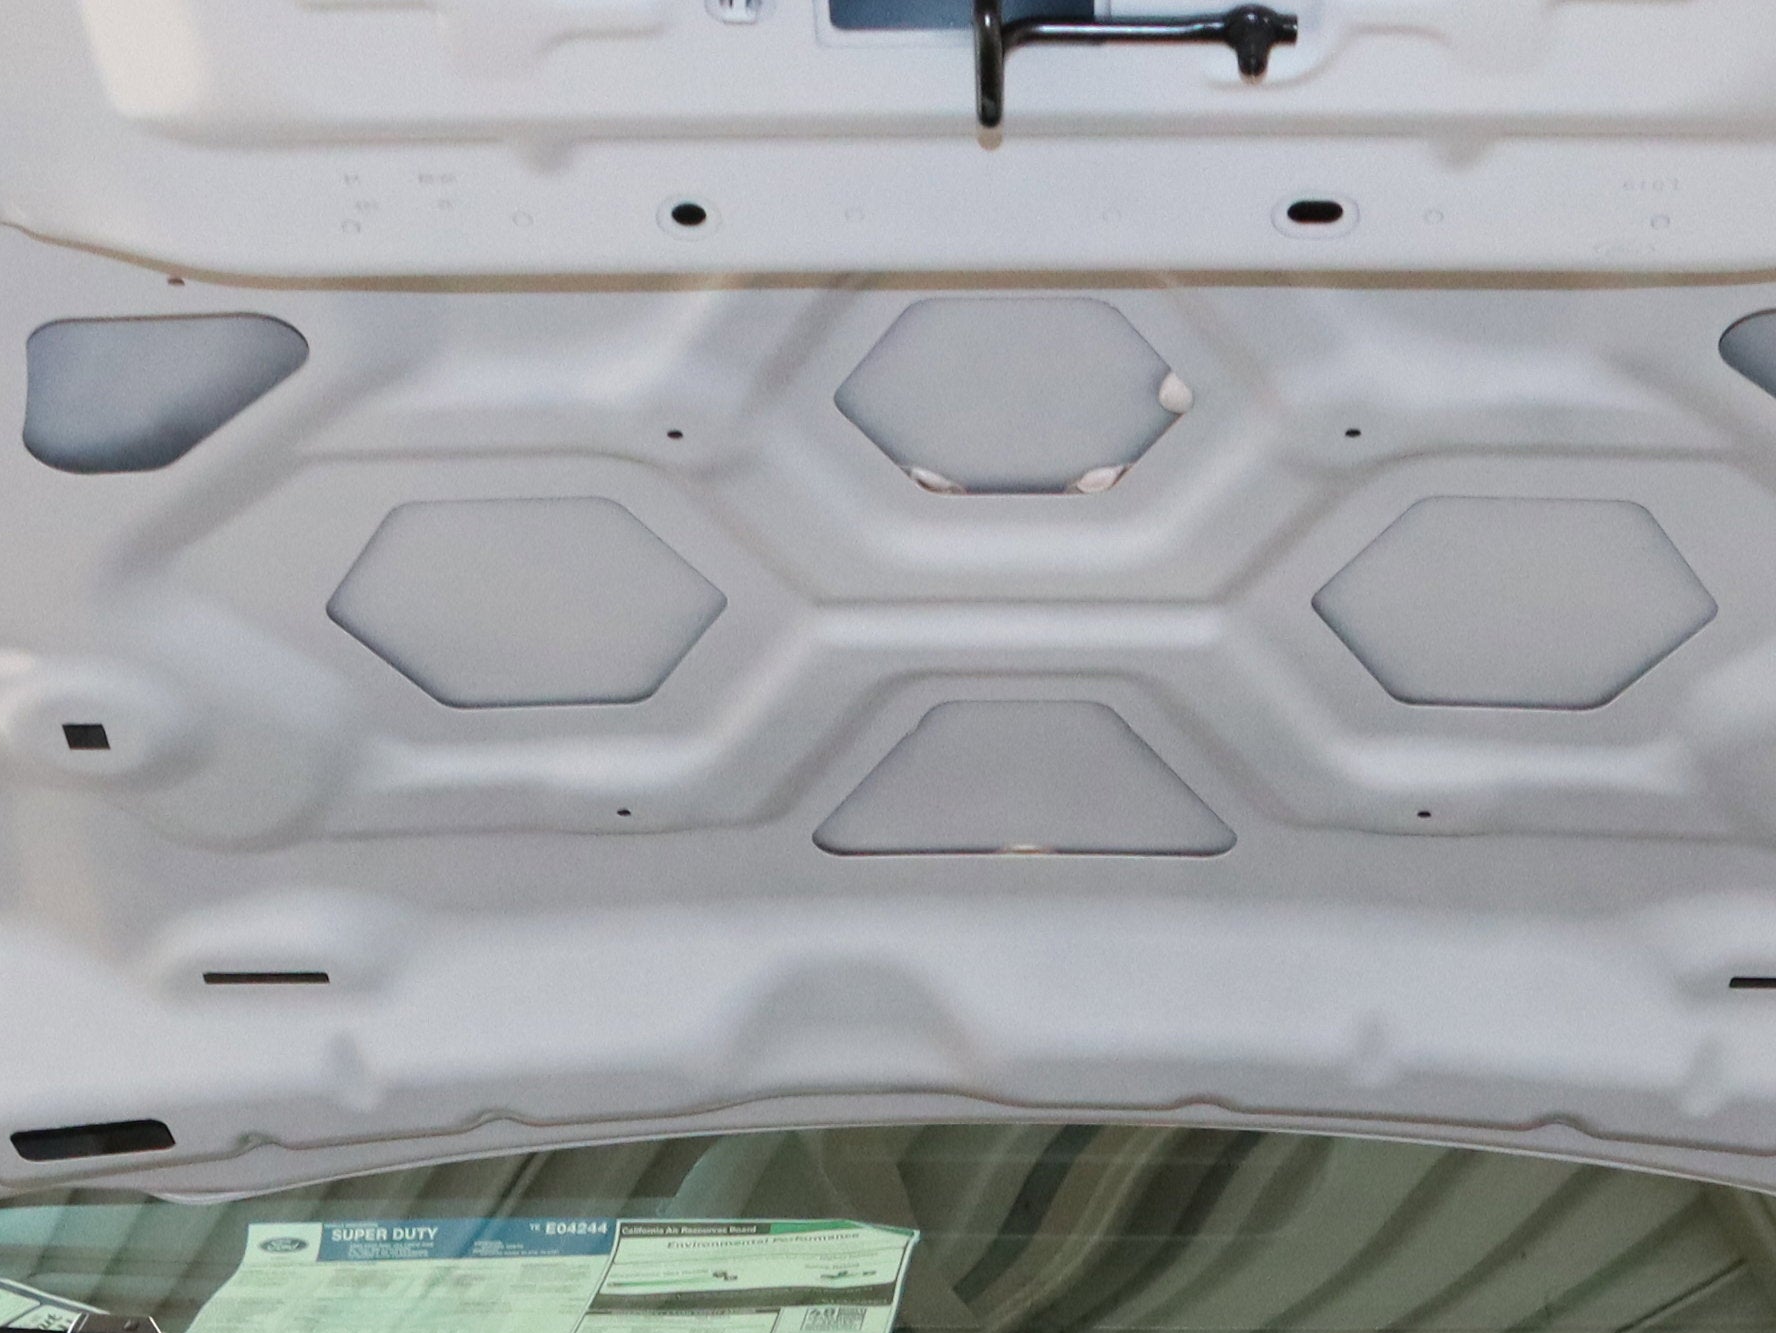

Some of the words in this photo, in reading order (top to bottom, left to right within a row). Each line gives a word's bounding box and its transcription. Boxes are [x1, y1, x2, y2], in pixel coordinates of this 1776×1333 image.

[331, 1228, 387, 1242] SUPER
[392, 1227, 438, 1240] DUTY
[546, 1221, 608, 1235] E04244
[621, 1226, 664, 1235] California
[728, 1225, 757, 1234] Board
